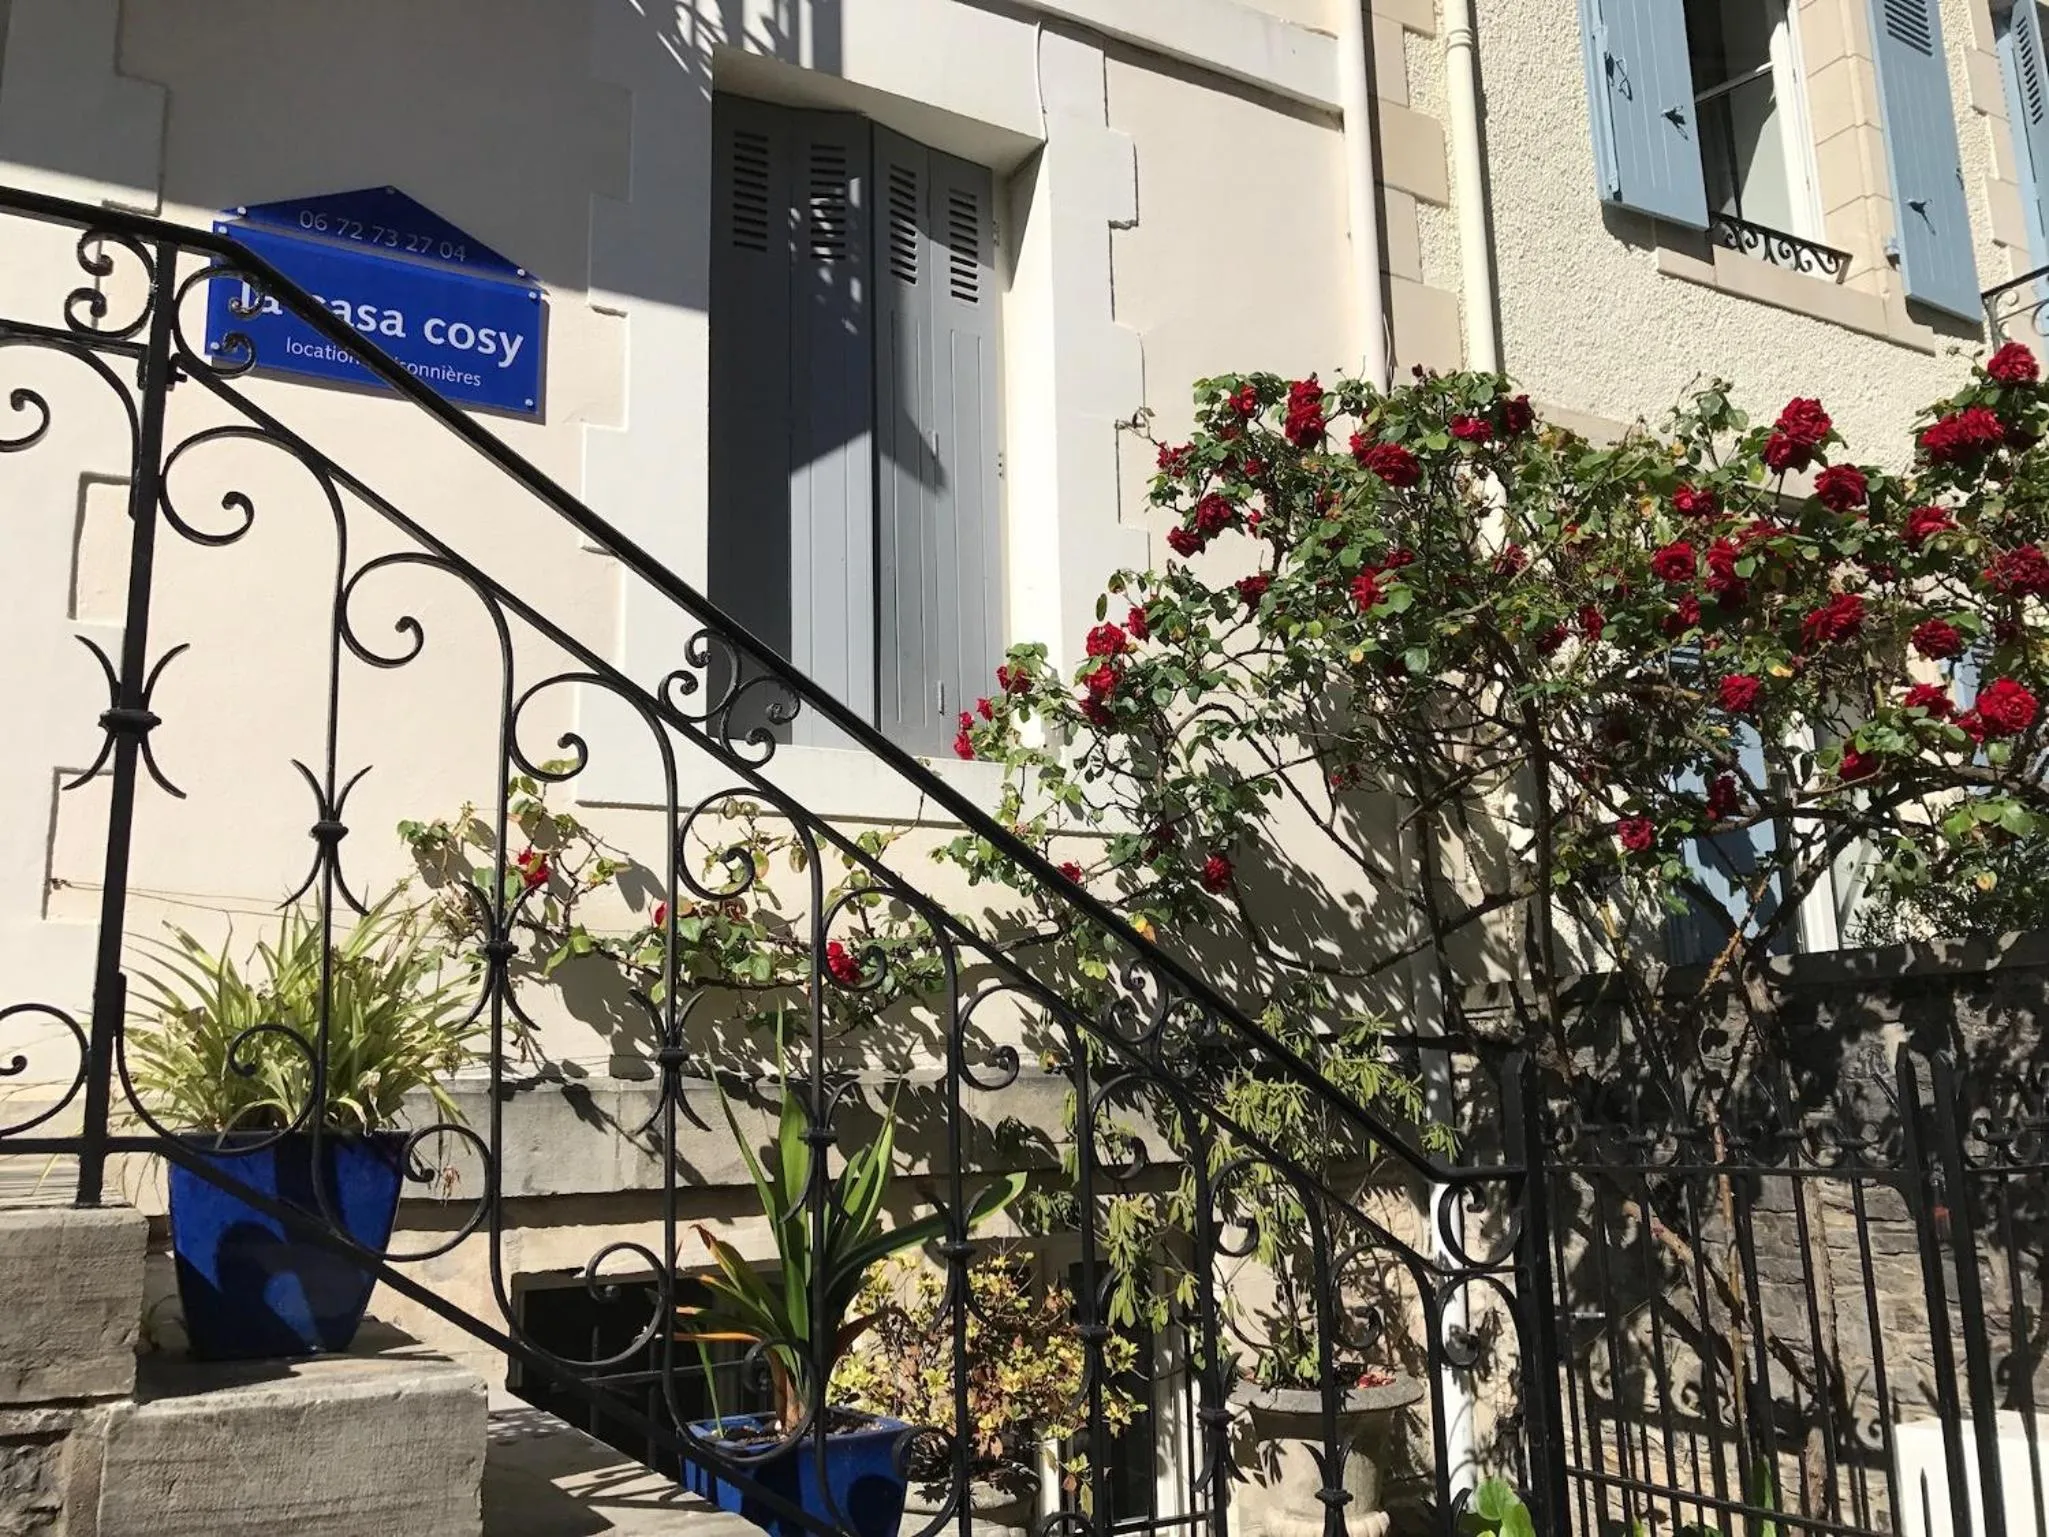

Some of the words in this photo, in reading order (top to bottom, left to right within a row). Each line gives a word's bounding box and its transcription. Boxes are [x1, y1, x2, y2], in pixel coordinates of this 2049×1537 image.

[299, 210, 328, 231] 06
[336, 217, 364, 240] 72
[371, 225, 399, 247] 73
[405, 234, 433, 254] 27
[439, 241, 467, 262] 04
[309, 294, 406, 338] asa
[424, 317, 524, 368] cosy
